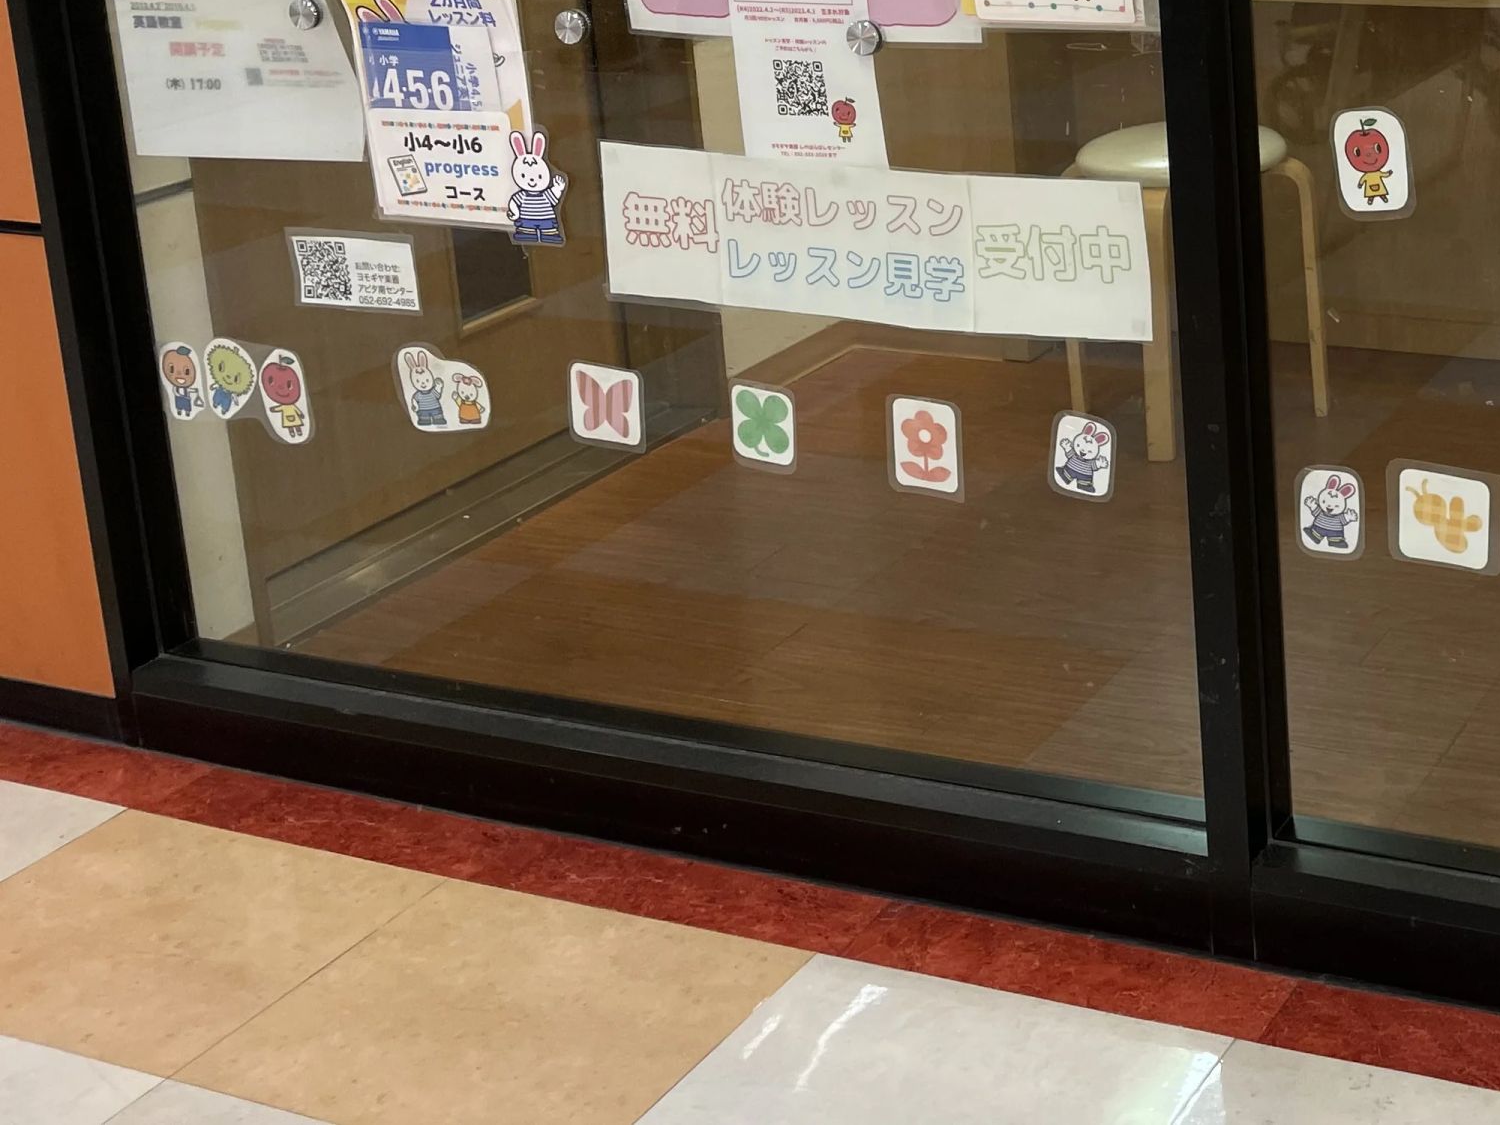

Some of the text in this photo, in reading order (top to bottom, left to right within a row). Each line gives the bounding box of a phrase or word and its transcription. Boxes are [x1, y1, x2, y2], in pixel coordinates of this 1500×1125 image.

[428, 10, 497, 27] レッスン料
[378, 28, 400, 36] YAMAHA
[379, 55, 399, 66] 小学
[425, 161, 499, 178] progress
[445, 186, 486, 201] コース
[722, 178, 963, 238] 体験レッスン
[623, 193, 720, 253] 無料
[976, 224, 1132, 283] 受付中
[727, 239, 965, 303] レッスン見学
